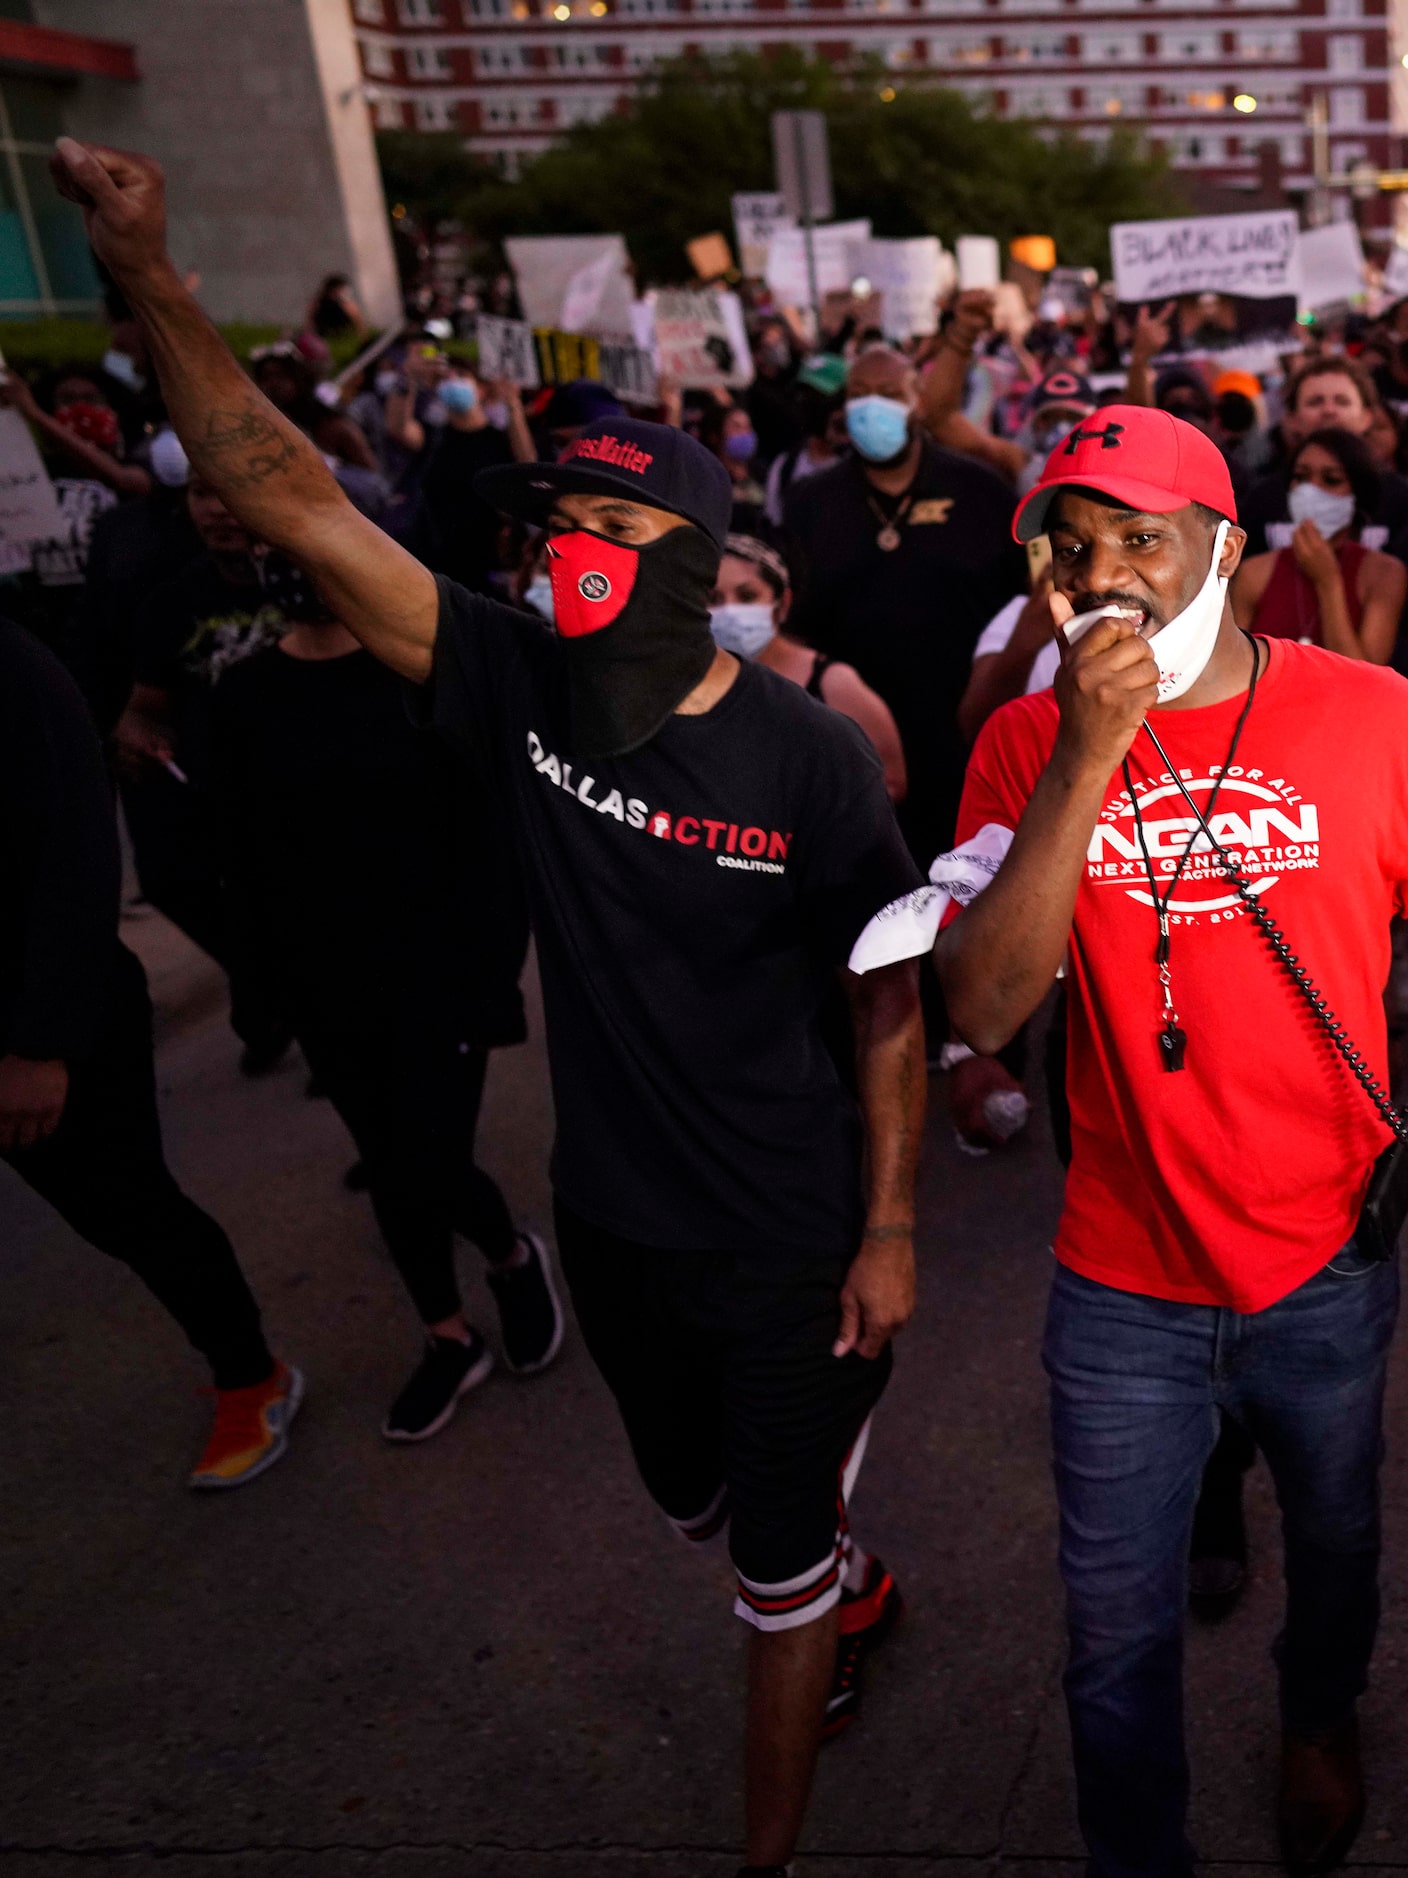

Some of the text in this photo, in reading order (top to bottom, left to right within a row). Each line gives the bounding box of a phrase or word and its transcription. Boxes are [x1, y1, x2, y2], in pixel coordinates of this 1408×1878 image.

[1100, 765, 1303, 822] JUSTICE FOR ALL
[1087, 804, 1320, 862] NGAN
[716, 855, 786, 874] COALITION
[1087, 844, 1320, 878] NEXT GENERATION
[1240, 857, 1320, 874] NETWORK
[1209, 906, 1245, 924] 201
